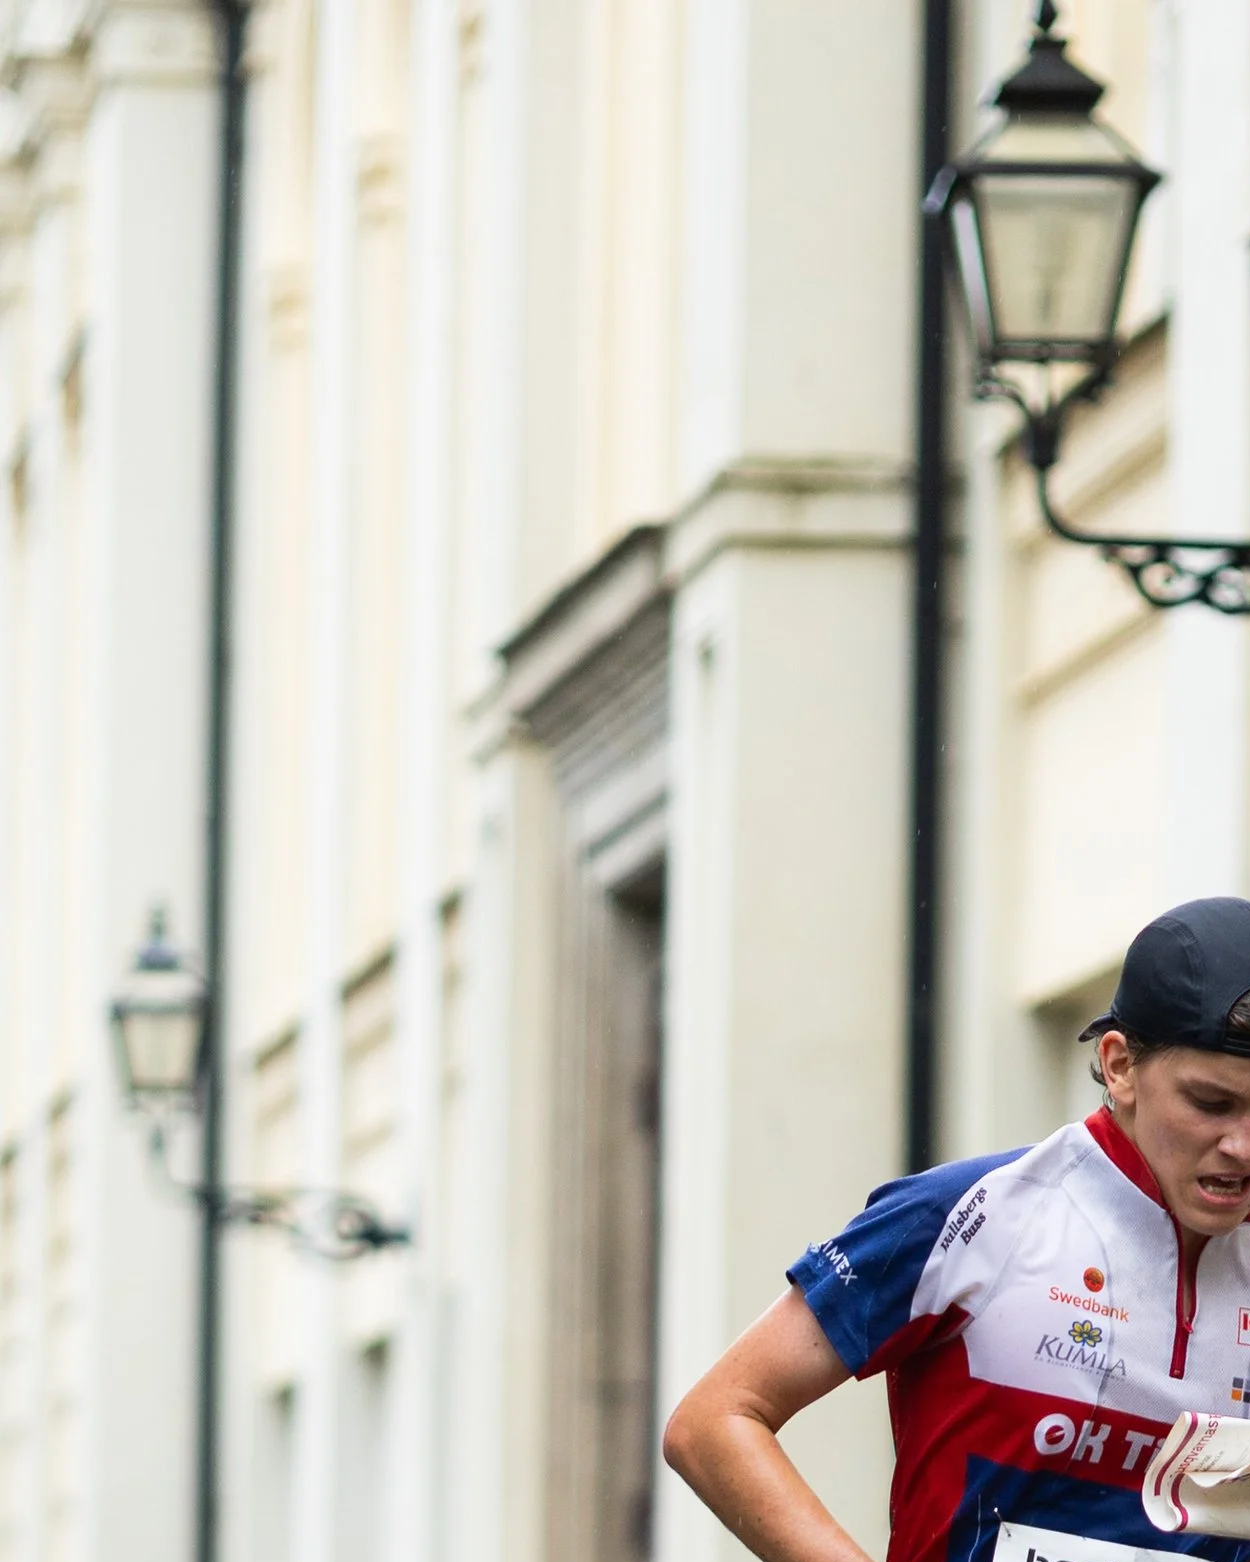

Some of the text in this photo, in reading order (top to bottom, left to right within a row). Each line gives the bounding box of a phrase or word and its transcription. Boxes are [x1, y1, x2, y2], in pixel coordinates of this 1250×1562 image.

[960, 1211, 987, 1246] Buss
[1048, 1286, 1130, 1322] Swedbank
[1035, 1333, 1127, 1376] KUMLA
[1033, 1412, 1112, 1465] OK
